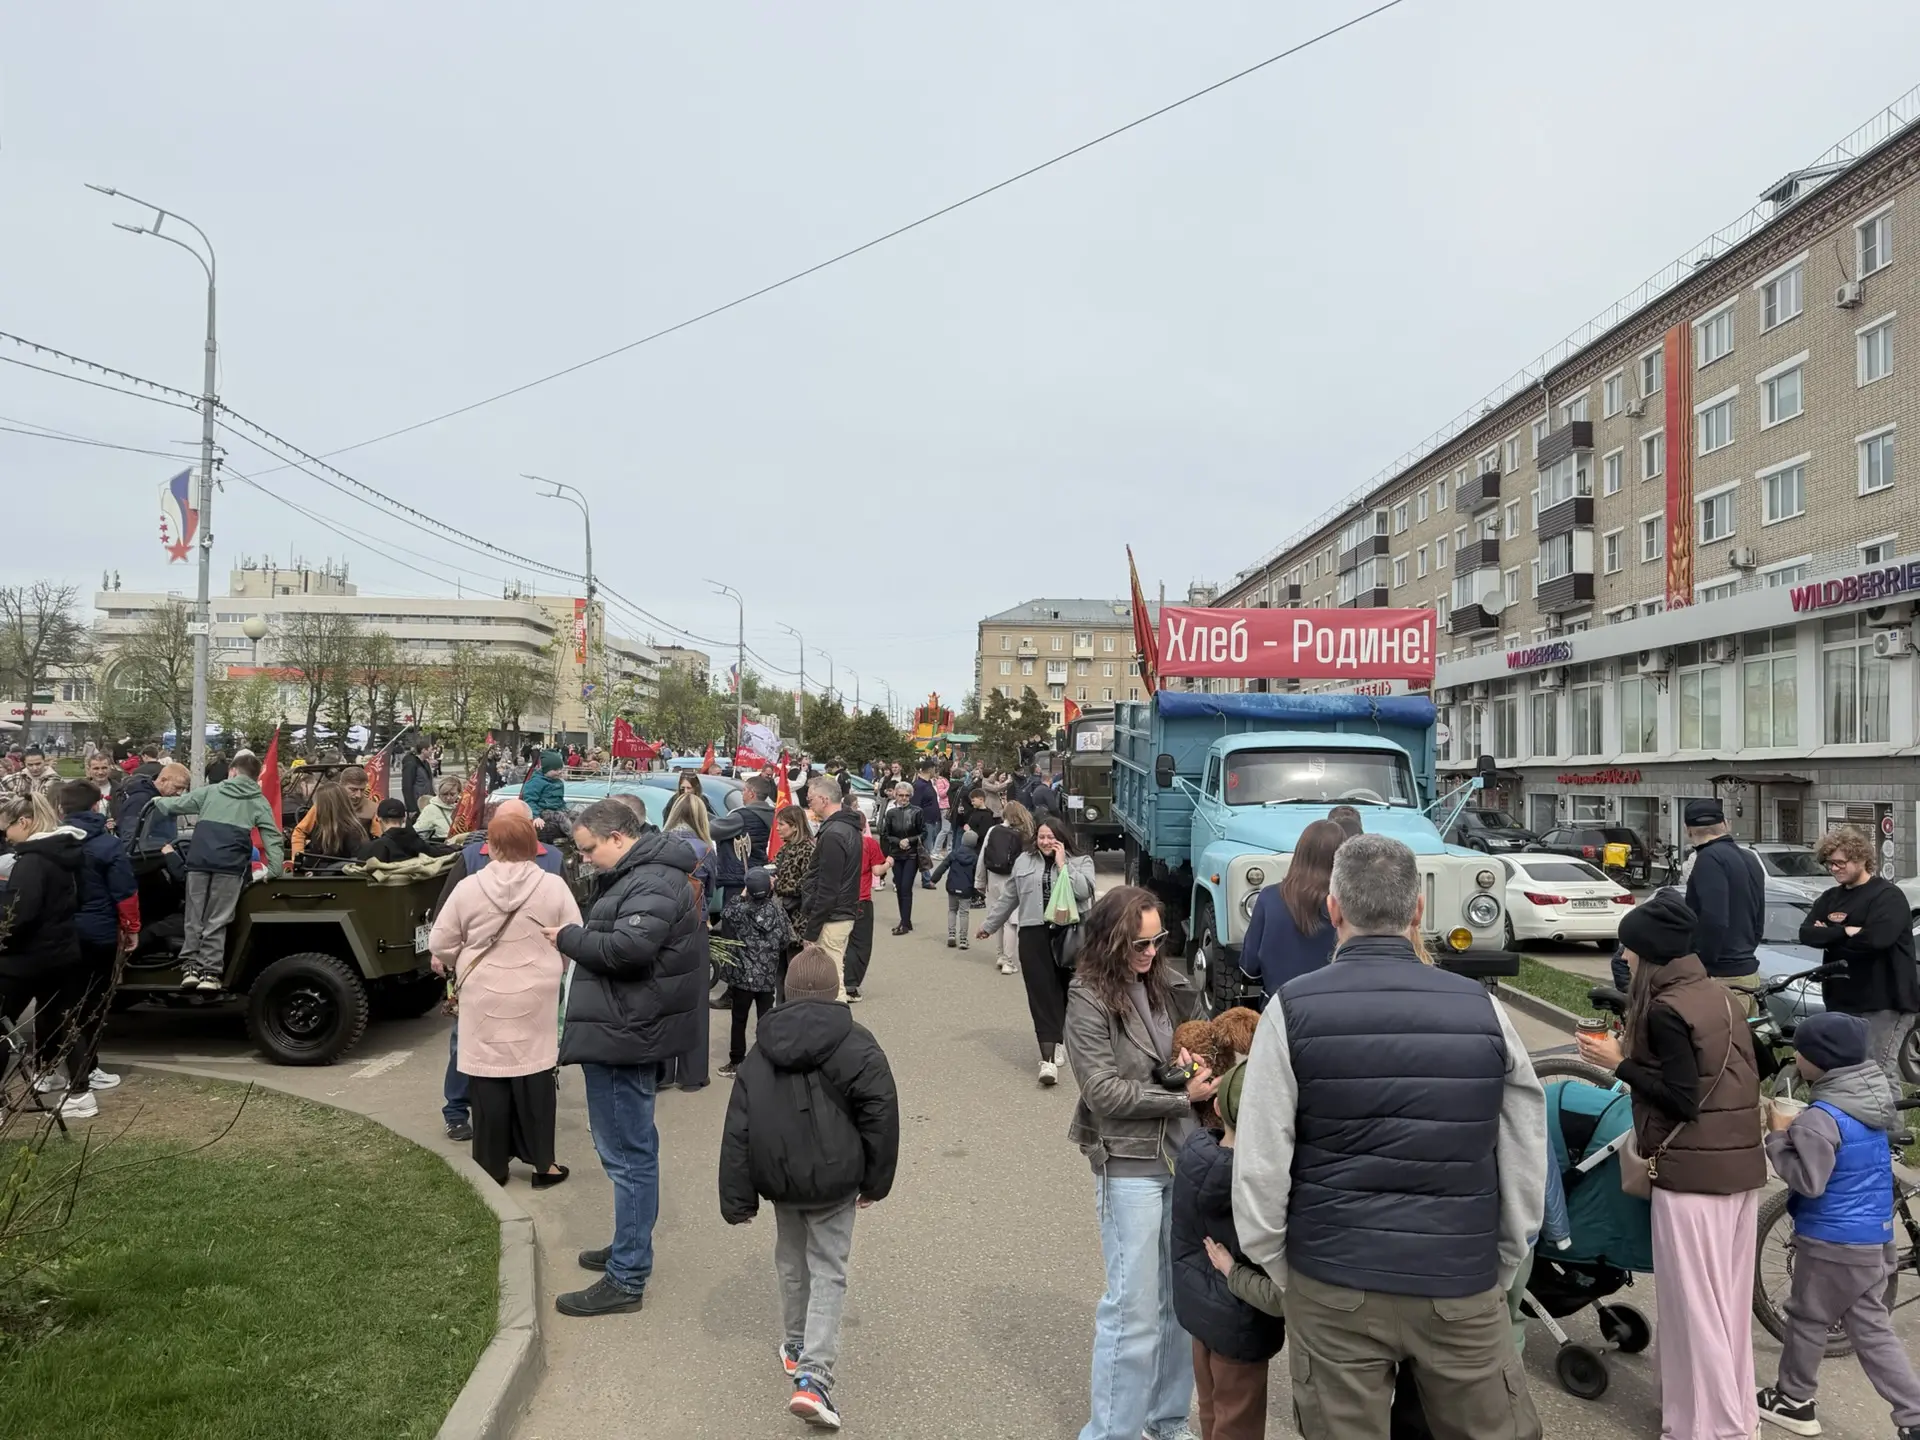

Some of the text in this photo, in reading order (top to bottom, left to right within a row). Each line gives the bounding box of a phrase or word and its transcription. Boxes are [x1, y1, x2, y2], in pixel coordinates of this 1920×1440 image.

[1790, 561, 1920, 612] WILDBERRIE
[1166, 618, 1248, 662] Хлеб
[1293, 619, 1430, 669] Родине!
[1507, 640, 1573, 669] WILDBERRIES
